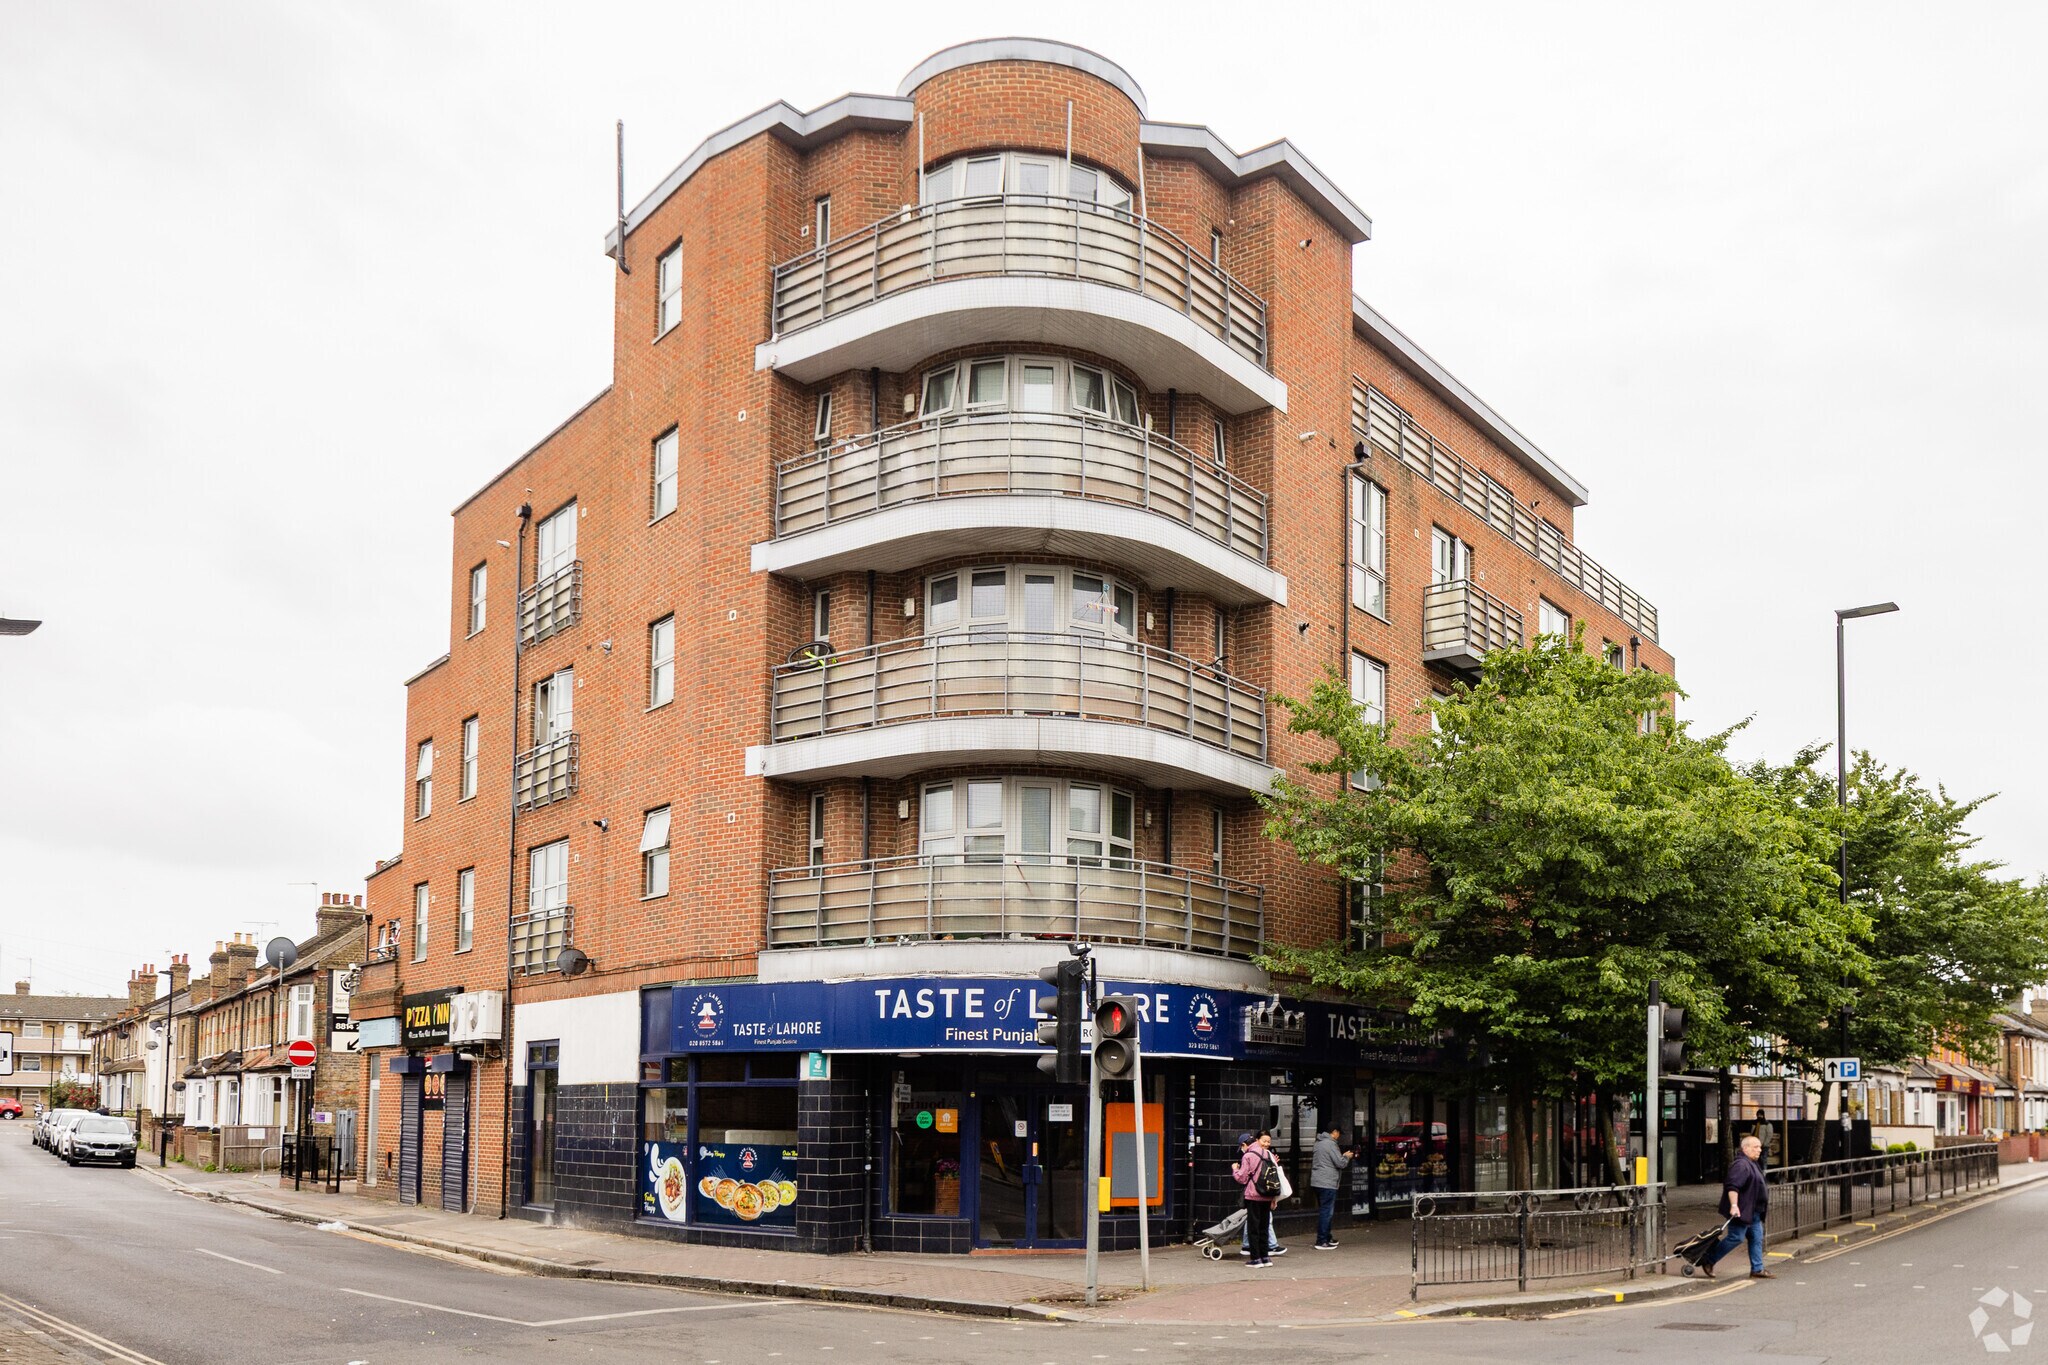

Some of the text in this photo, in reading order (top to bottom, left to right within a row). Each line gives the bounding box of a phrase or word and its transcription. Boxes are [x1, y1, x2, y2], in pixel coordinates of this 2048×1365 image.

[884, 988, 985, 1019] TASTE
[994, 988, 1021, 1020] of
[335, 1022, 354, 1030] 8814
[733, 1022, 766, 1036] TASTE
[776, 1021, 822, 1035] LAHORE
[945, 1027, 989, 1041] Finest
[1360, 1049, 1418, 1064] Finest Punjabi Cuisine
[1844, 1063, 1855, 1076] P
